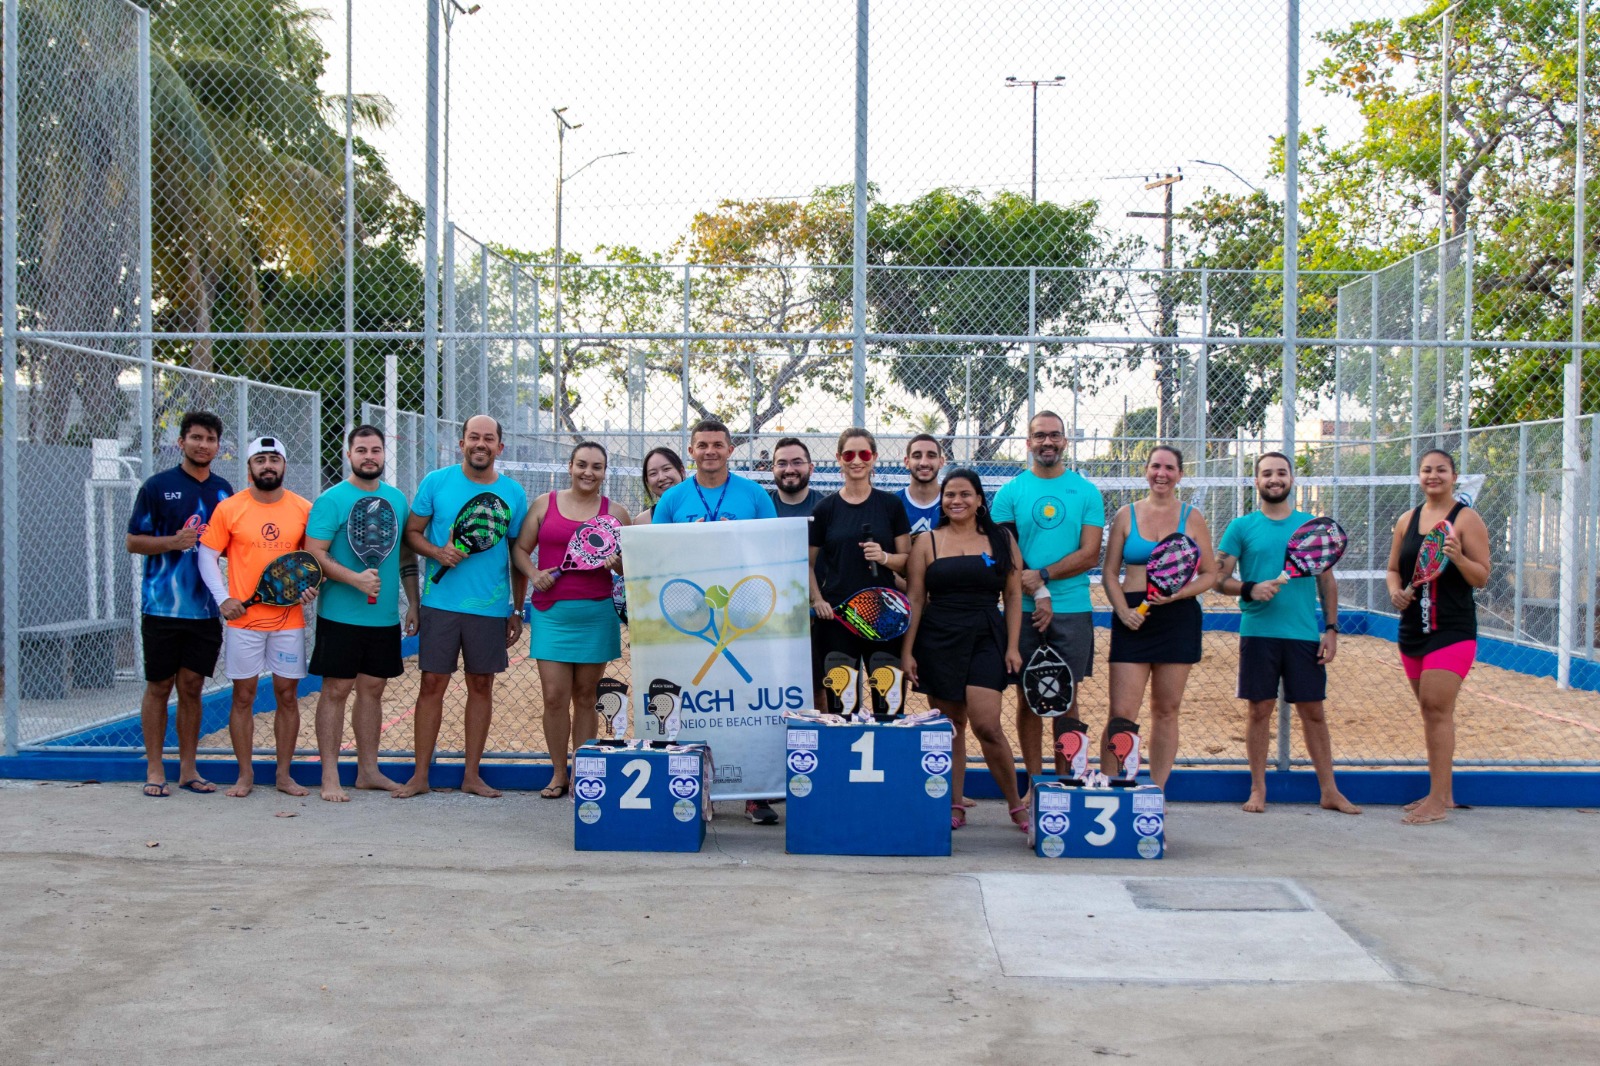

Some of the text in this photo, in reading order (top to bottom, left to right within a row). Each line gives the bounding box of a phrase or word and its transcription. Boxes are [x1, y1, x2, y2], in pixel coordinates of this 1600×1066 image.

[164, 491, 182, 500] EA7
[1421, 608, 1430, 633] BLACK
[748, 686, 804, 711] JUS
[681, 719, 706, 729] NEIO
[709, 718, 723, 728] DE
[726, 716, 762, 727] BEACH
[765, 715, 787, 726] TEN
[850, 732, 884, 782] 1
[619, 758, 652, 809] 2
[1085, 797, 1119, 845] 3
